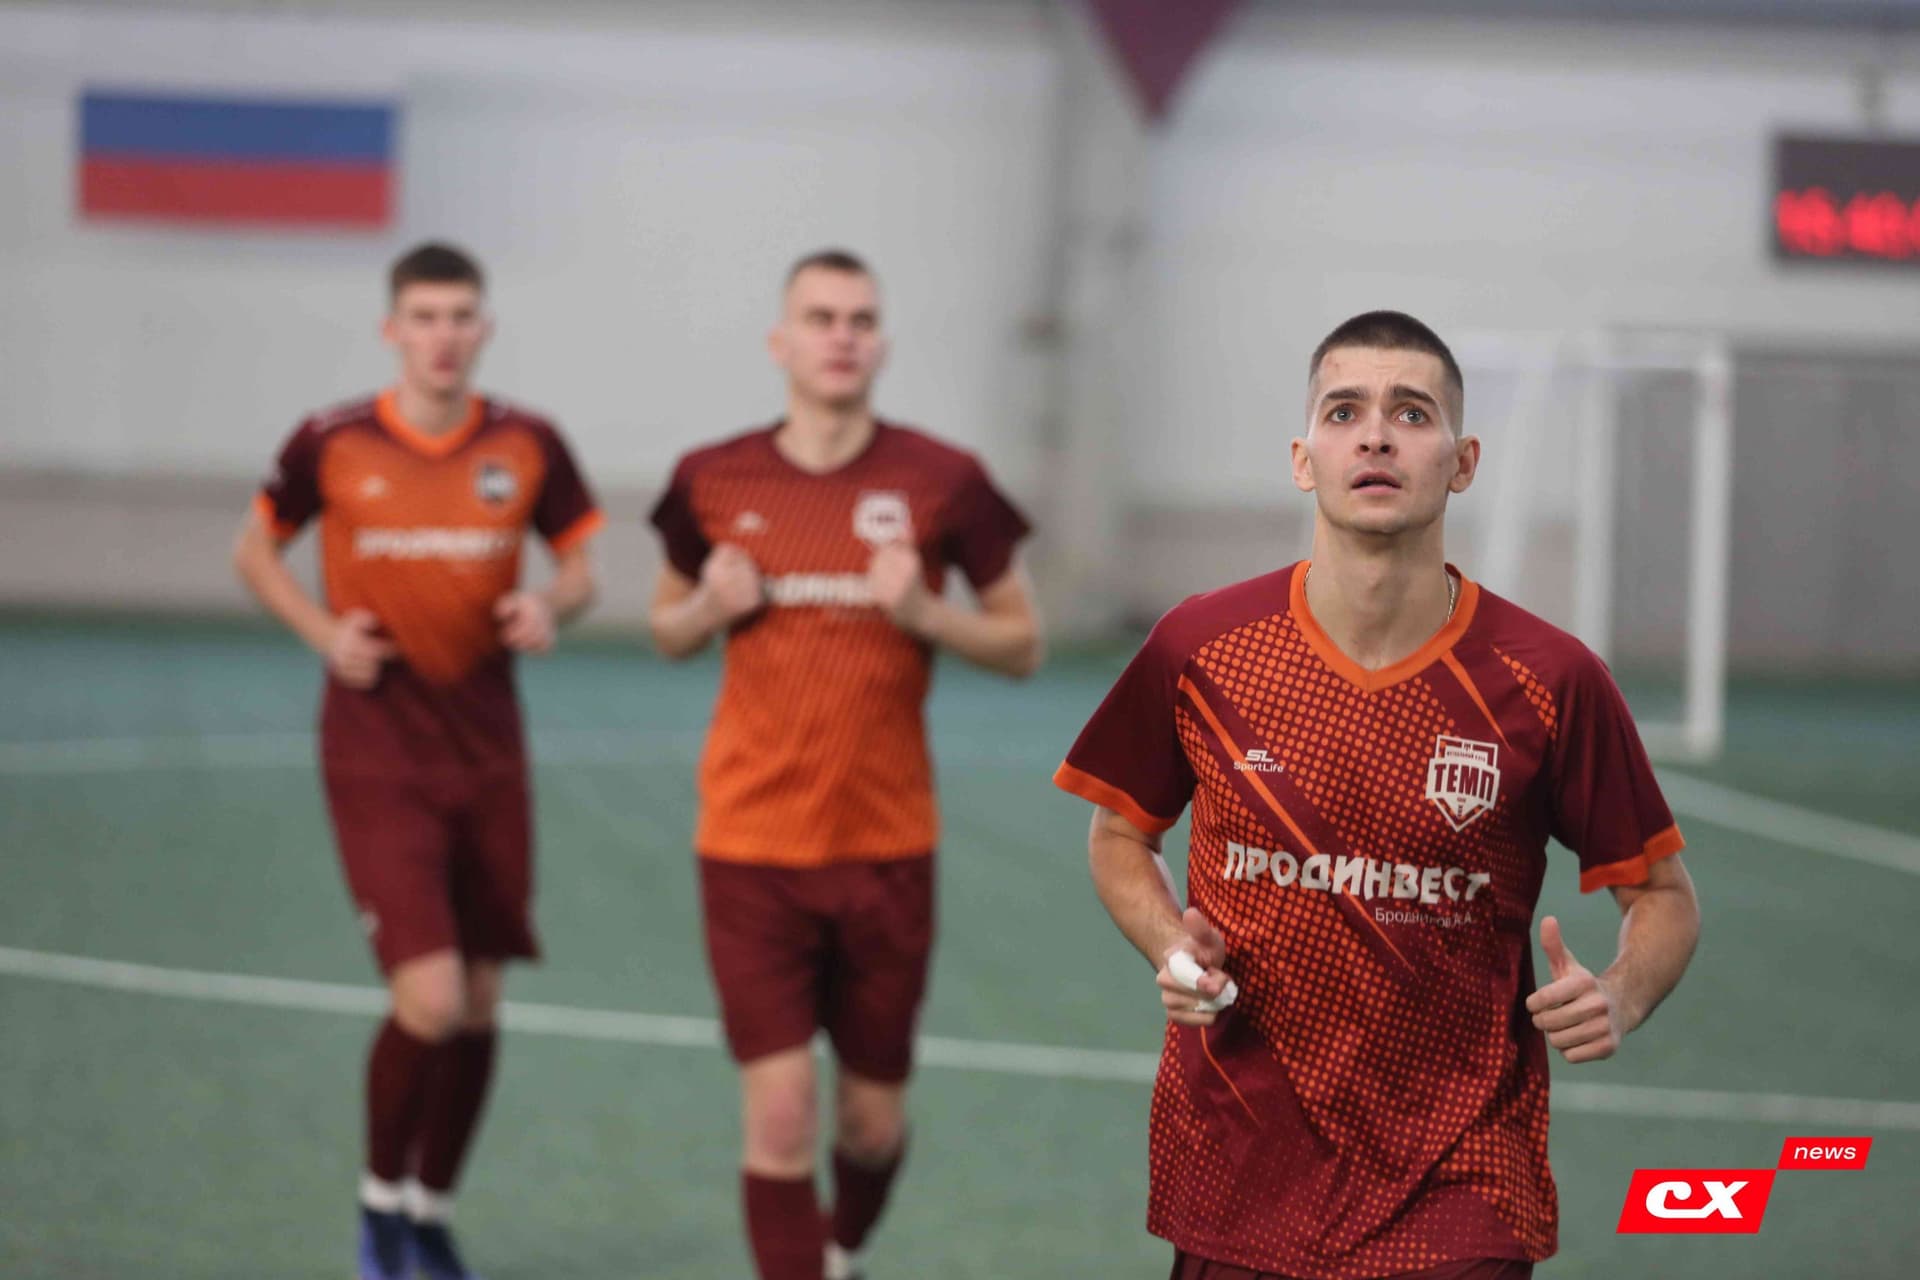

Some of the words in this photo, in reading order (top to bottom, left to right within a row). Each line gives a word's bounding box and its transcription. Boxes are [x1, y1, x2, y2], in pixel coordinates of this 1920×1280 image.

[1233, 760, 1284, 773] SportLife
[1245, 749, 1274, 762] SL
[1433, 763, 1495, 803] ТЕМП
[1223, 840, 1490, 904] ПРОДИНВЕСТ
